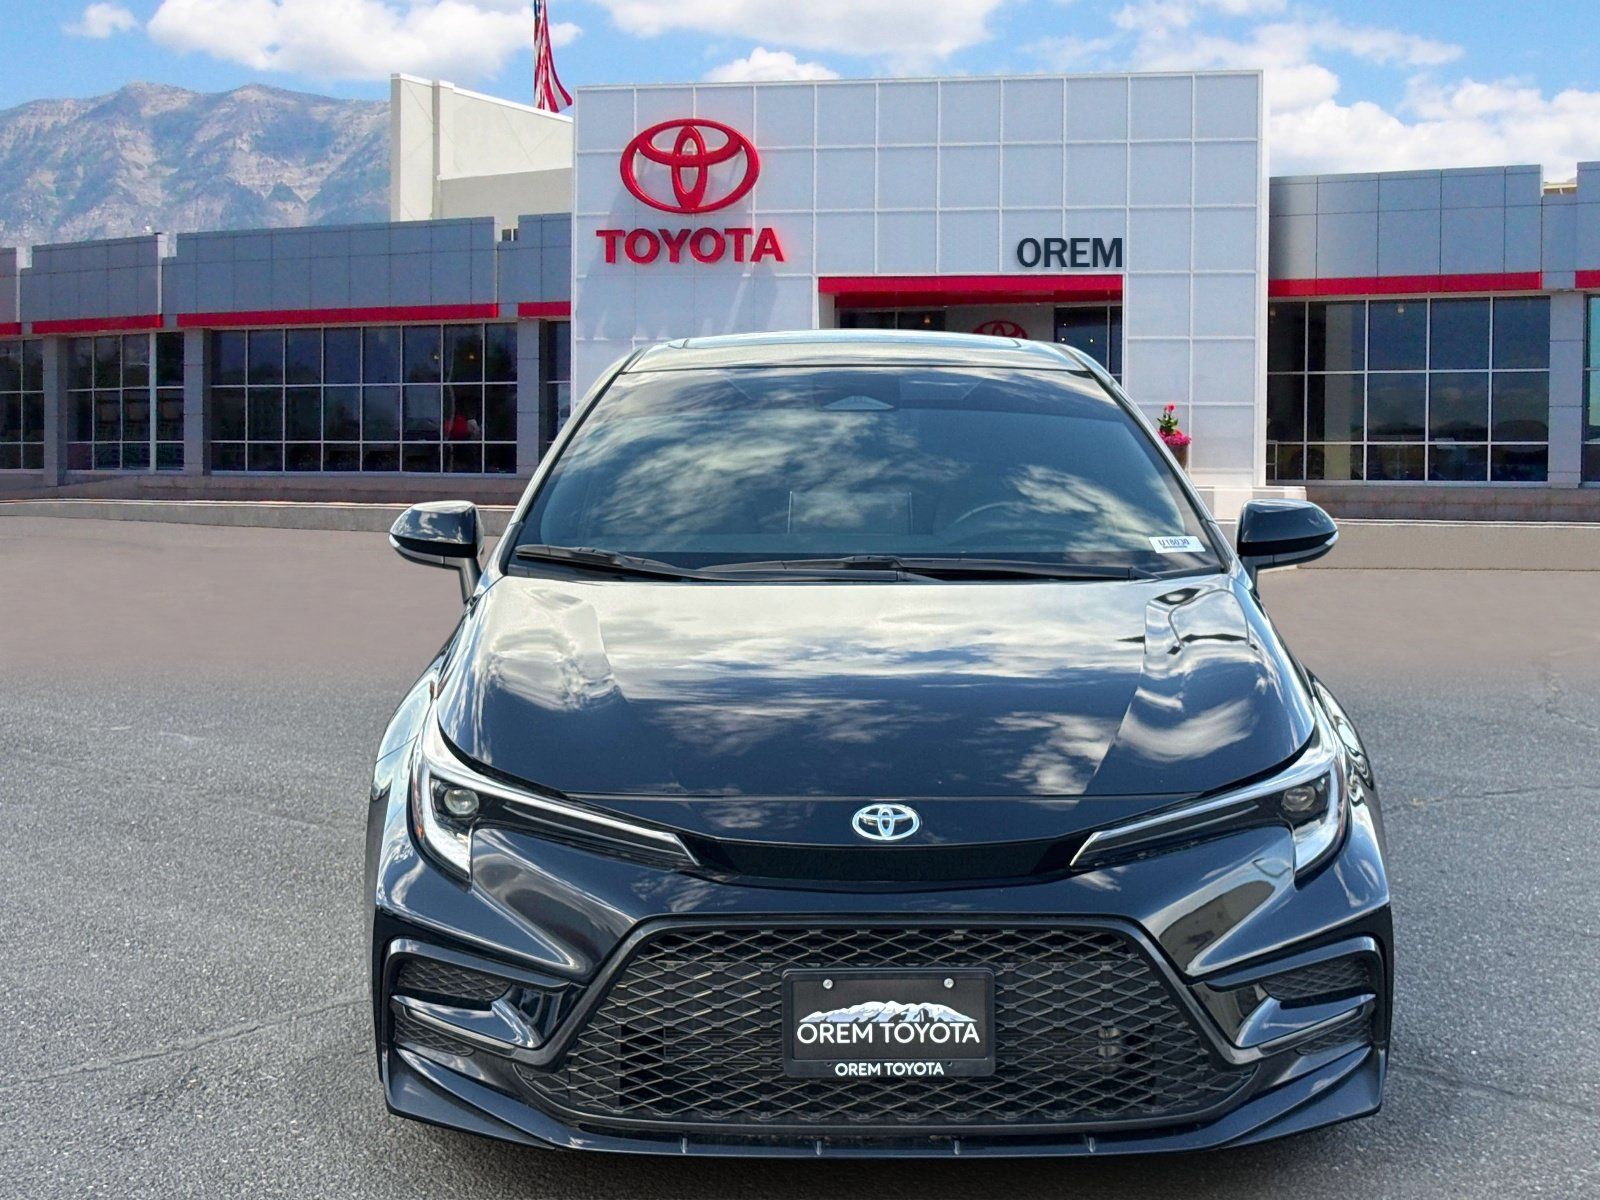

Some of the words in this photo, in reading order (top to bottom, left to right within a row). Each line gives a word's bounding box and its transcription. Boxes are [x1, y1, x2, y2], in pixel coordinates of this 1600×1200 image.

[596, 227, 784, 264] TOYOTA
[1016, 237, 1123, 269] OREM
[796, 1023, 873, 1044] OREM
[879, 1023, 980, 1044] TOYOTA
[834, 1062, 881, 1077] OREM
[884, 1062, 945, 1077] TOYOTA
